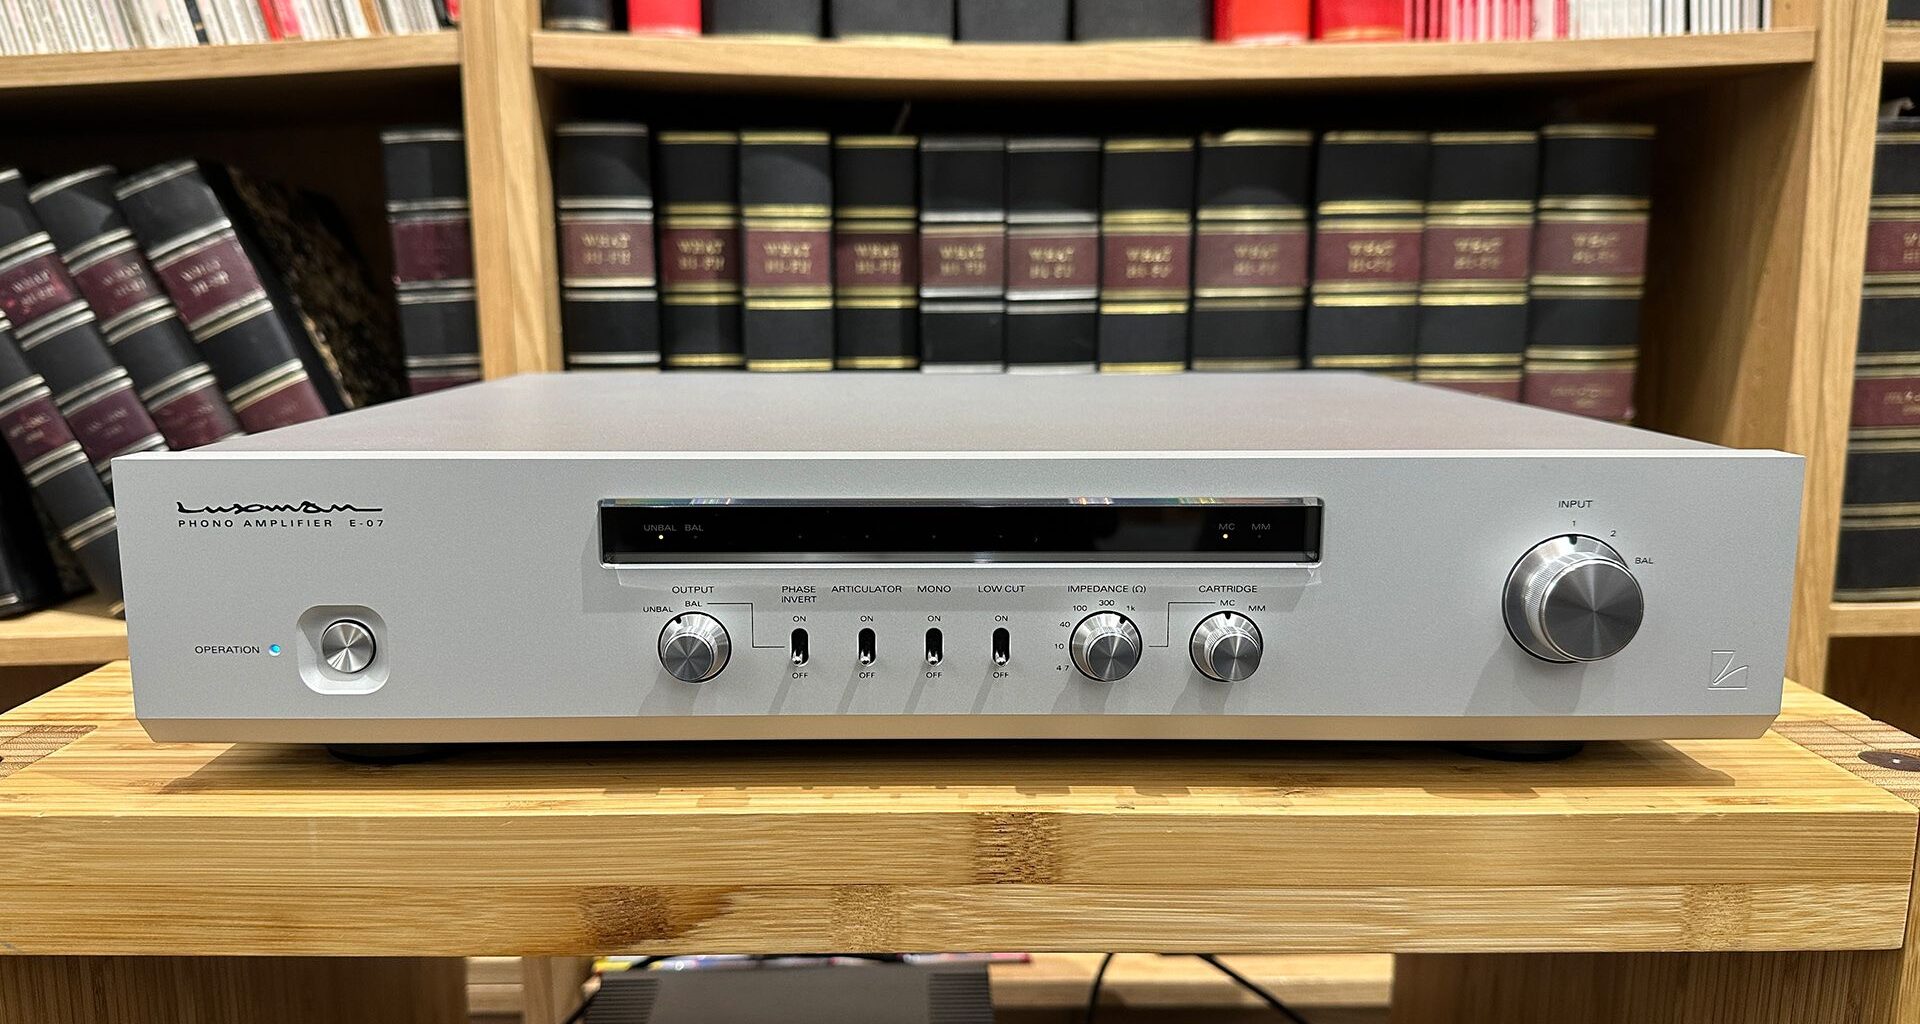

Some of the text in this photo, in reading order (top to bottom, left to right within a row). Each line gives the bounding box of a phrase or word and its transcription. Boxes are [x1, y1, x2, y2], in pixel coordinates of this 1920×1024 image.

[1558, 499, 1593, 509] INPUT
[178, 519, 384, 528] PHONO AMPLIFIER E-07
[643, 523, 677, 532] UNBAL
[684, 523, 704, 532] BAL
[1218, 522, 1236, 531] MC
[1251, 523, 1271, 531] MM
[1610, 529, 1617, 538] 2
[1634, 556, 1654, 565] BAL
[671, 585, 714, 594] OUTPUT
[781, 585, 816, 594] PHASE
[831, 585, 902, 594] ARTICULATOR
[917, 585, 952, 594] MONO
[977, 585, 1026, 594] LOW CUT
[1067, 584, 1129, 593] IMPEDANCE
[1198, 584, 1258, 594] CARTRIDGE
[684, 600, 703, 608] BAL
[781, 595, 817, 604] INVERT
[1098, 599, 1115, 607] 300
[1219, 599, 1236, 607] MC
[642, 605, 674, 613] UNBAL
[1072, 604, 1088, 612] 100
[1248, 604, 1267, 612] MM
[926, 614, 942, 622] ON
[994, 614, 1009, 622] ON
[194, 645, 260, 654] OPERATION
[791, 671, 808, 679] OFF
[858, 671, 875, 679] OFF
[925, 671, 942, 679] OFF
[992, 671, 1009, 679] OFF
